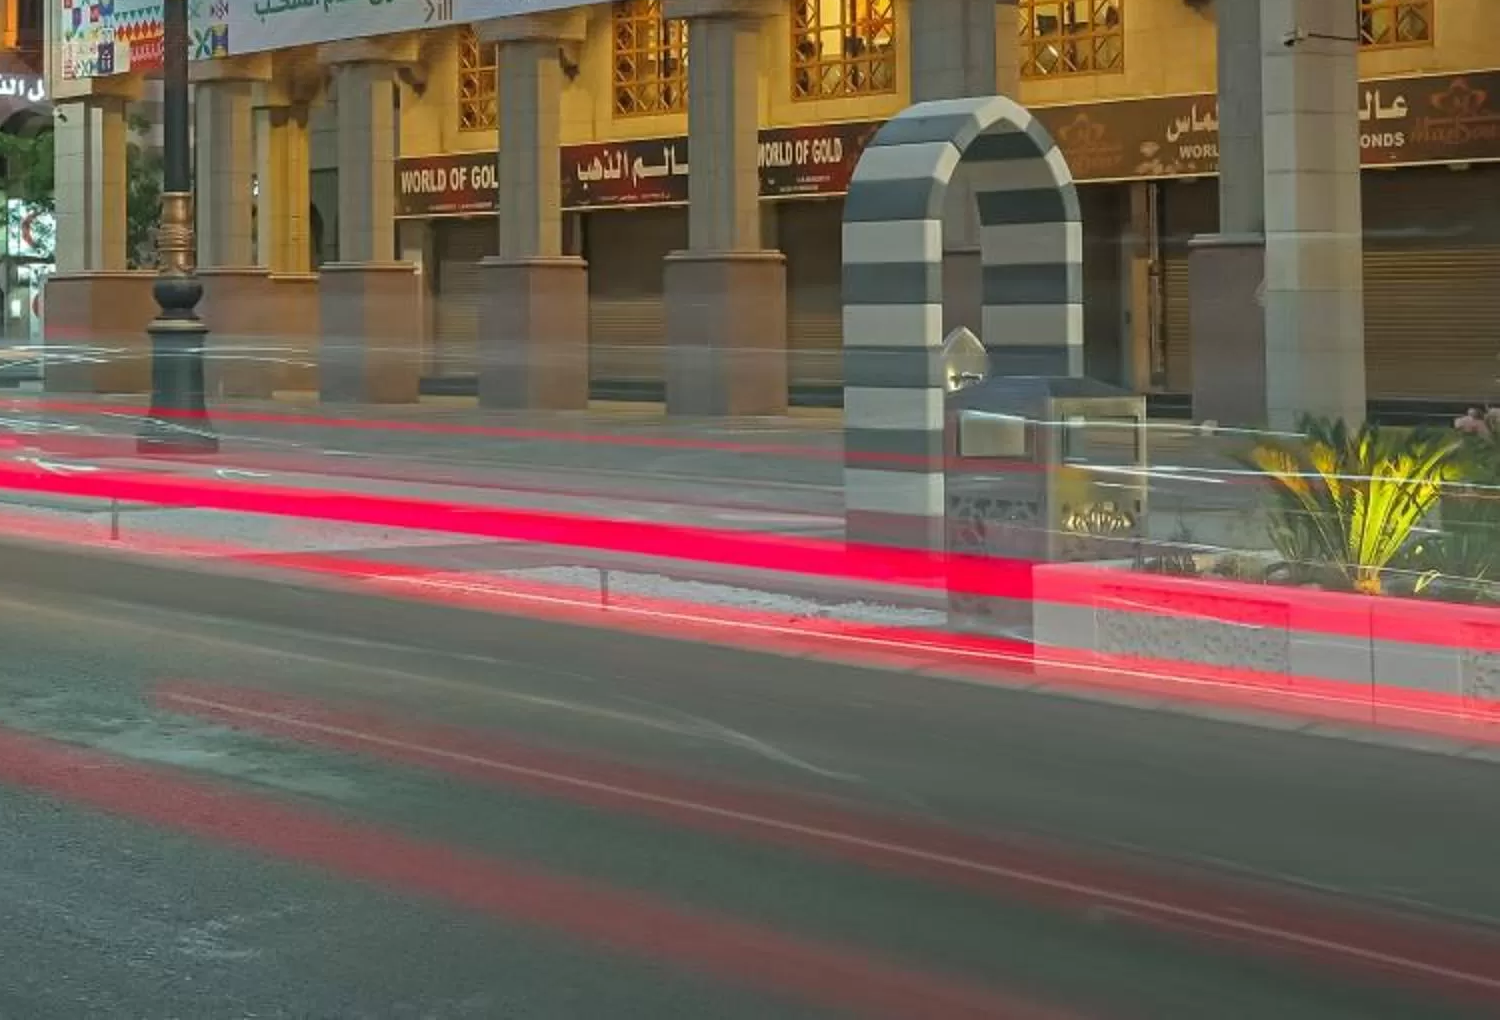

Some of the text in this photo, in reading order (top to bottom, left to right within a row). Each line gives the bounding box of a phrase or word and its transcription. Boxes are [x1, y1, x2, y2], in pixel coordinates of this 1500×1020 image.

[795, 139, 810, 165] OF
[811, 137, 844, 164] GOLD
[1179, 143, 1221, 160] WORL
[401, 164, 499, 194] WORLD OF GOL
[577, 148, 630, 191] الذهب
